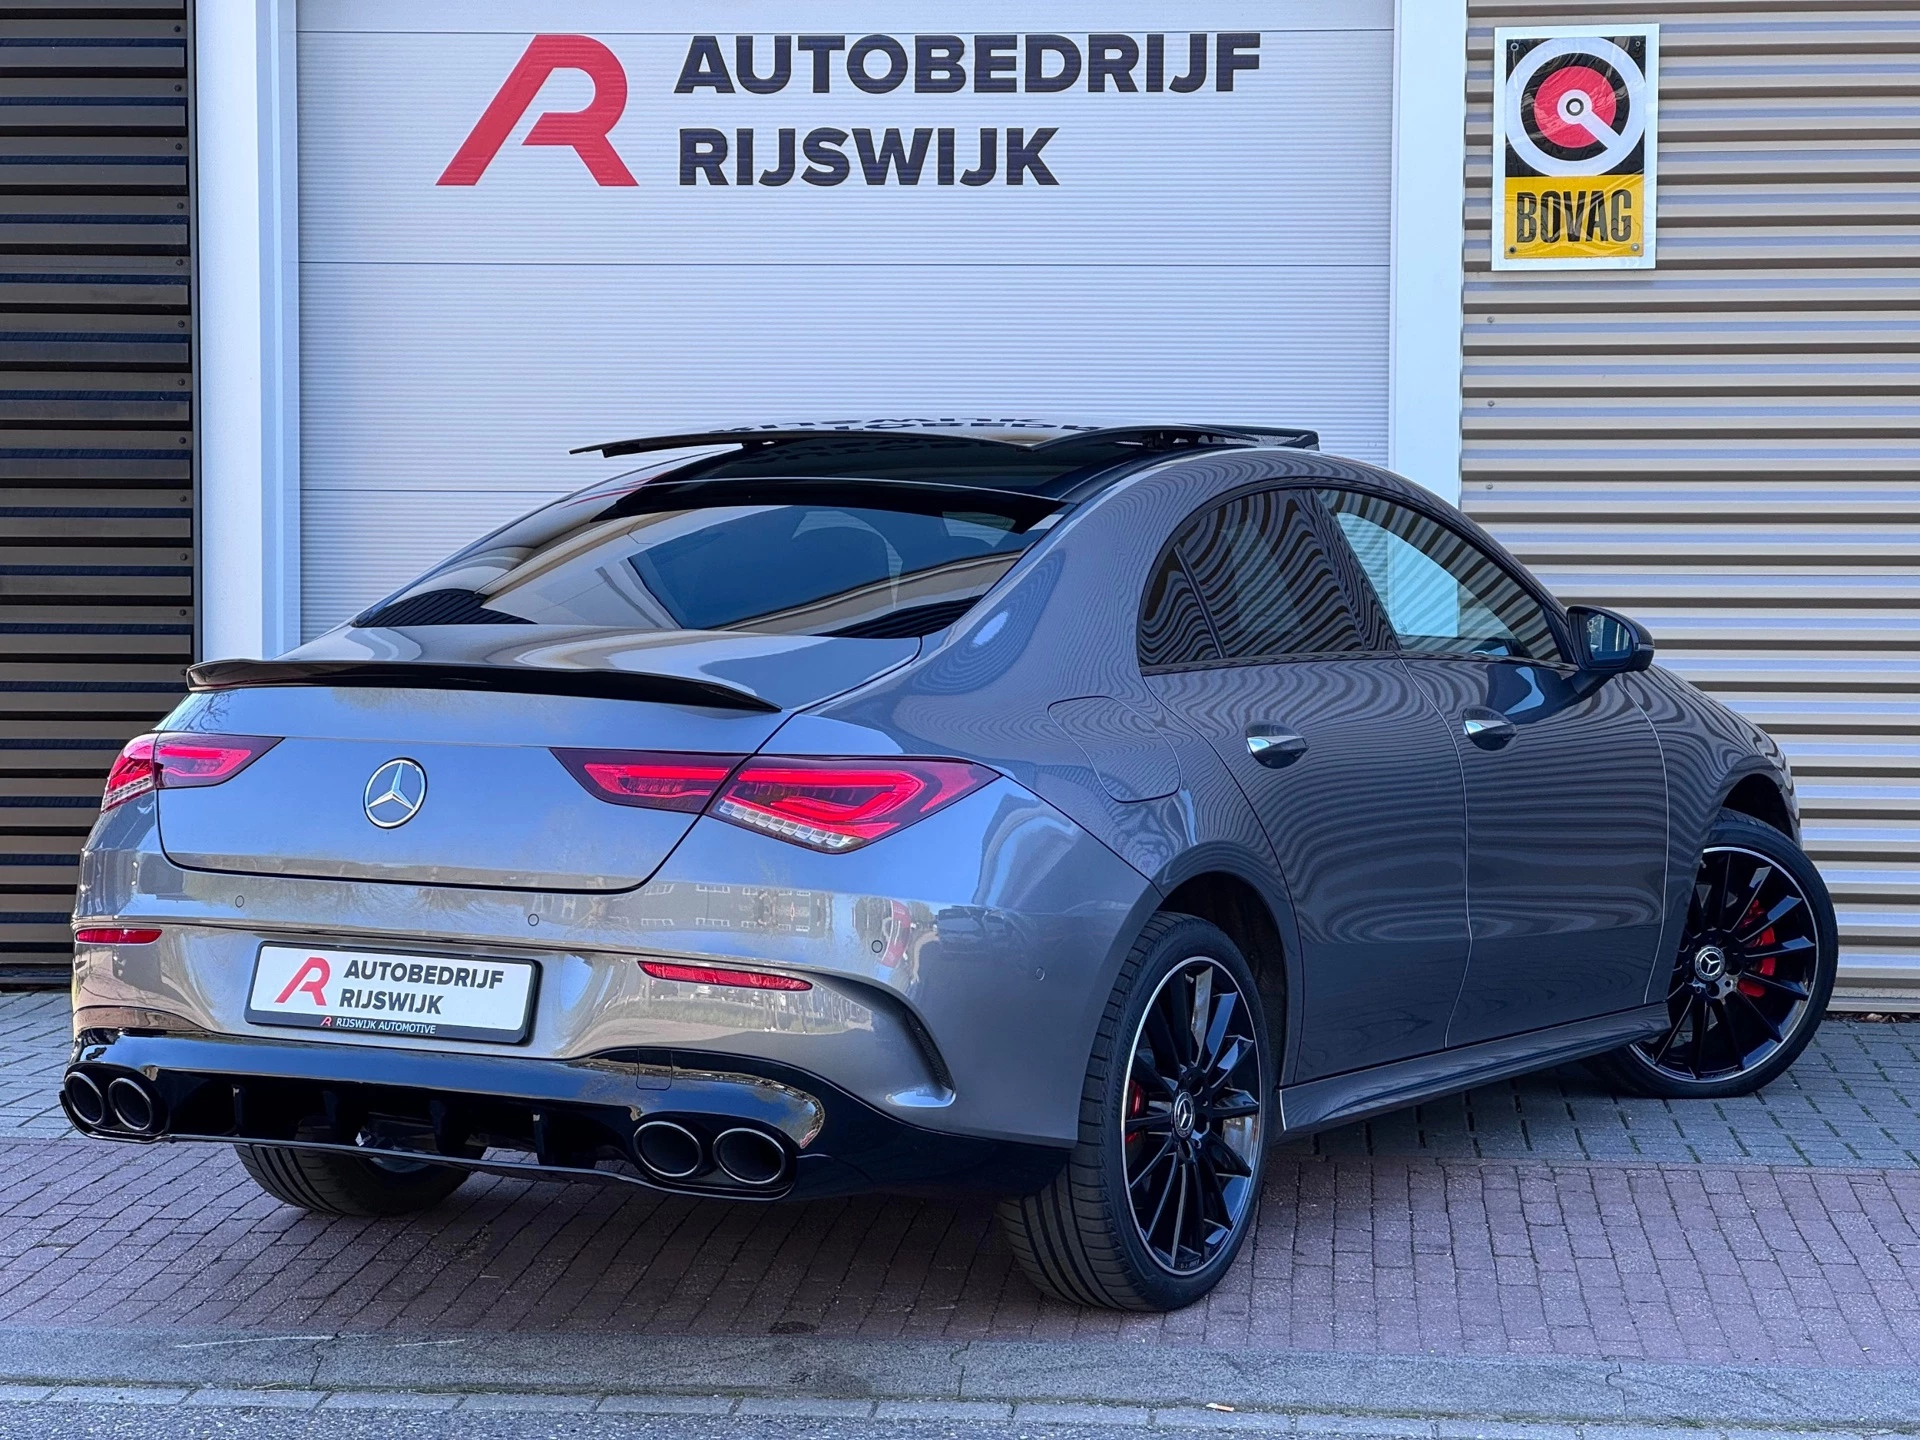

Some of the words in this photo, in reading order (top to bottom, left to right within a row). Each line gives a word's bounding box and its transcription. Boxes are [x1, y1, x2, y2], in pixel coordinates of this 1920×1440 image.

[673, 33, 1261, 95] AUTOBEDRIJF
[680, 128, 1060, 187] RIJSWIJK
[1516, 188, 1632, 244] BOVAG
[343, 959, 505, 990] AUTOBEDRIJF
[339, 988, 444, 1015] RIJSWIJK
[336, 1017, 377, 1030] RIJSWIJK
[378, 1022, 437, 1035] AUTOMOTIVE
